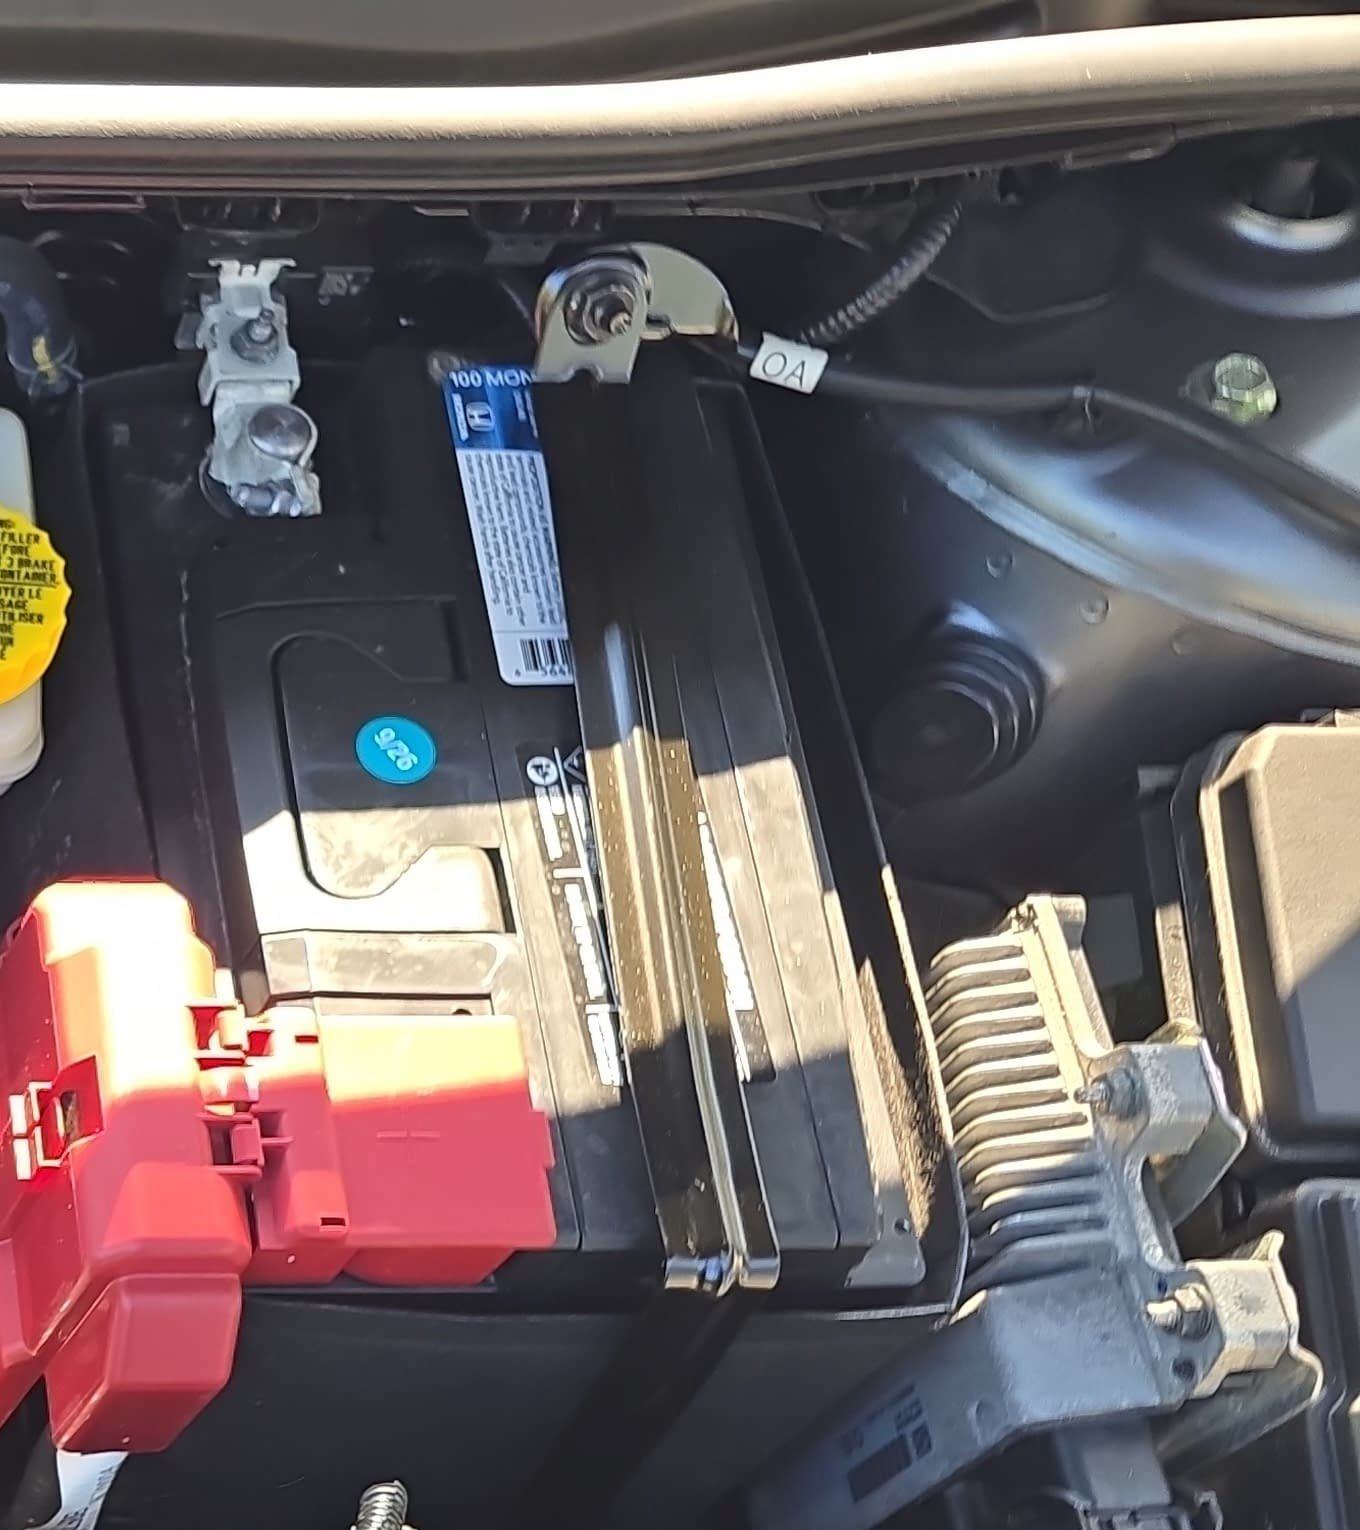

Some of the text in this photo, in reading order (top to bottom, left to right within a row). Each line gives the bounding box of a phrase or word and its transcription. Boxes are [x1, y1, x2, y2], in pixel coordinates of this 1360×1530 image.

[449, 370, 482, 388] 100
[1, 531, 40, 544] FILLER
[17, 558, 55, 571] BRAKE
[29, 588, 42, 600] LE
[374, 727, 418, 771] 9/26
